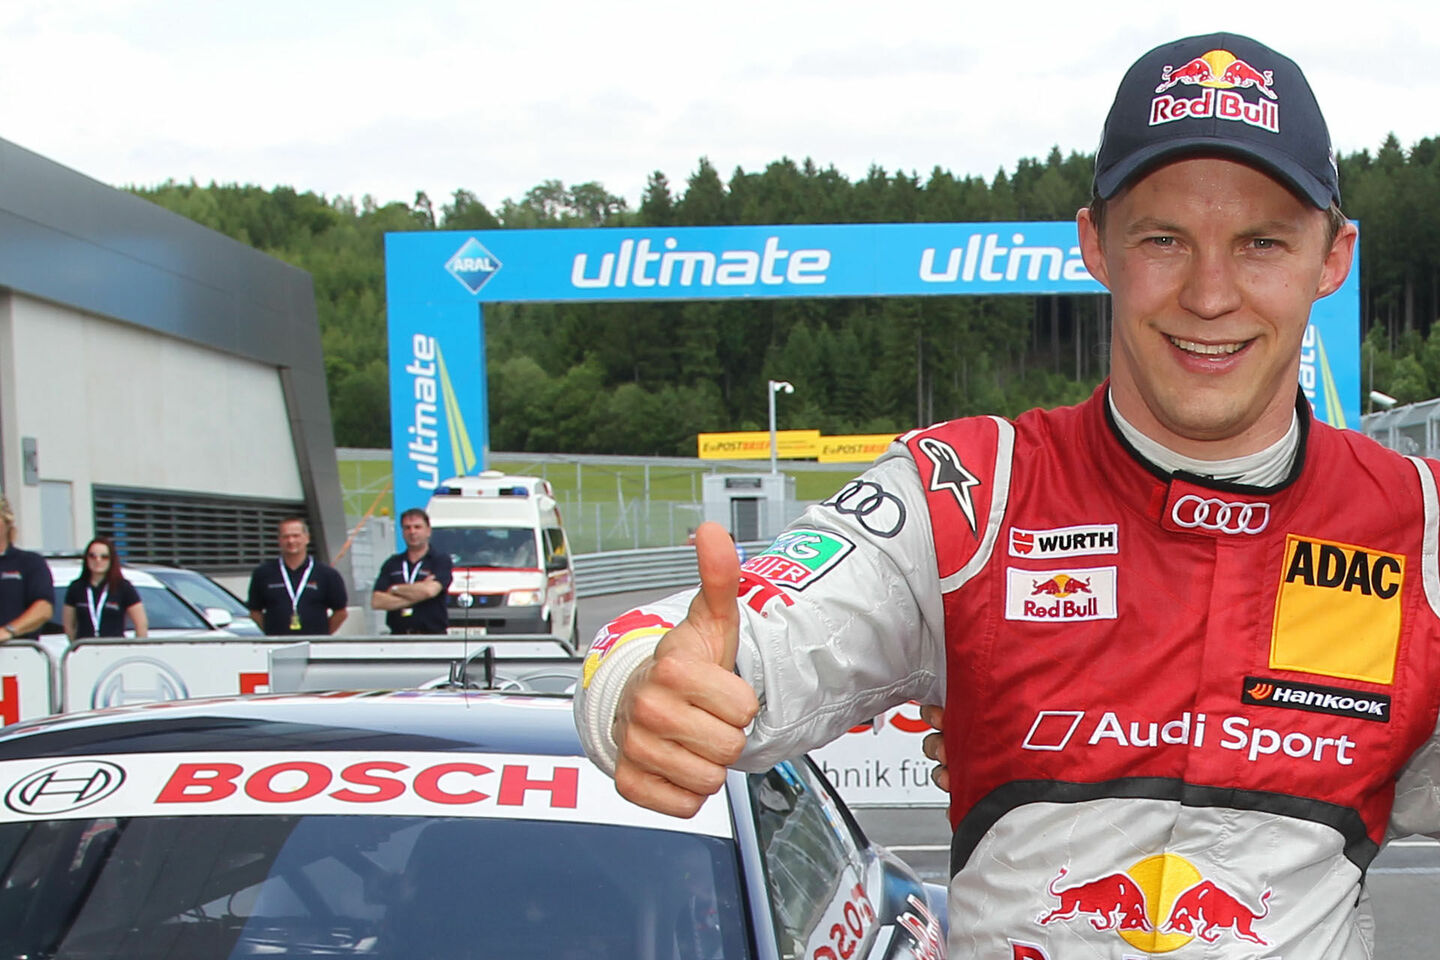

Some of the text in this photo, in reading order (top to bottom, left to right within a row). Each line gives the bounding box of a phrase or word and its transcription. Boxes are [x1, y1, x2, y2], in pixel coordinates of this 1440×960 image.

[1151, 89, 1278, 131] Red Bull
[453, 256, 494, 273] ARAL
[571, 236, 831, 288] ultimate
[919, 233, 1091, 283] ultima
[405, 333, 440, 490] ultimate
[1286, 541, 1401, 599] ADAC
[1023, 597, 1098, 618] Red Bull
[1088, 712, 1356, 765] Audi Sport
[154, 760, 578, 808] BOSCH
